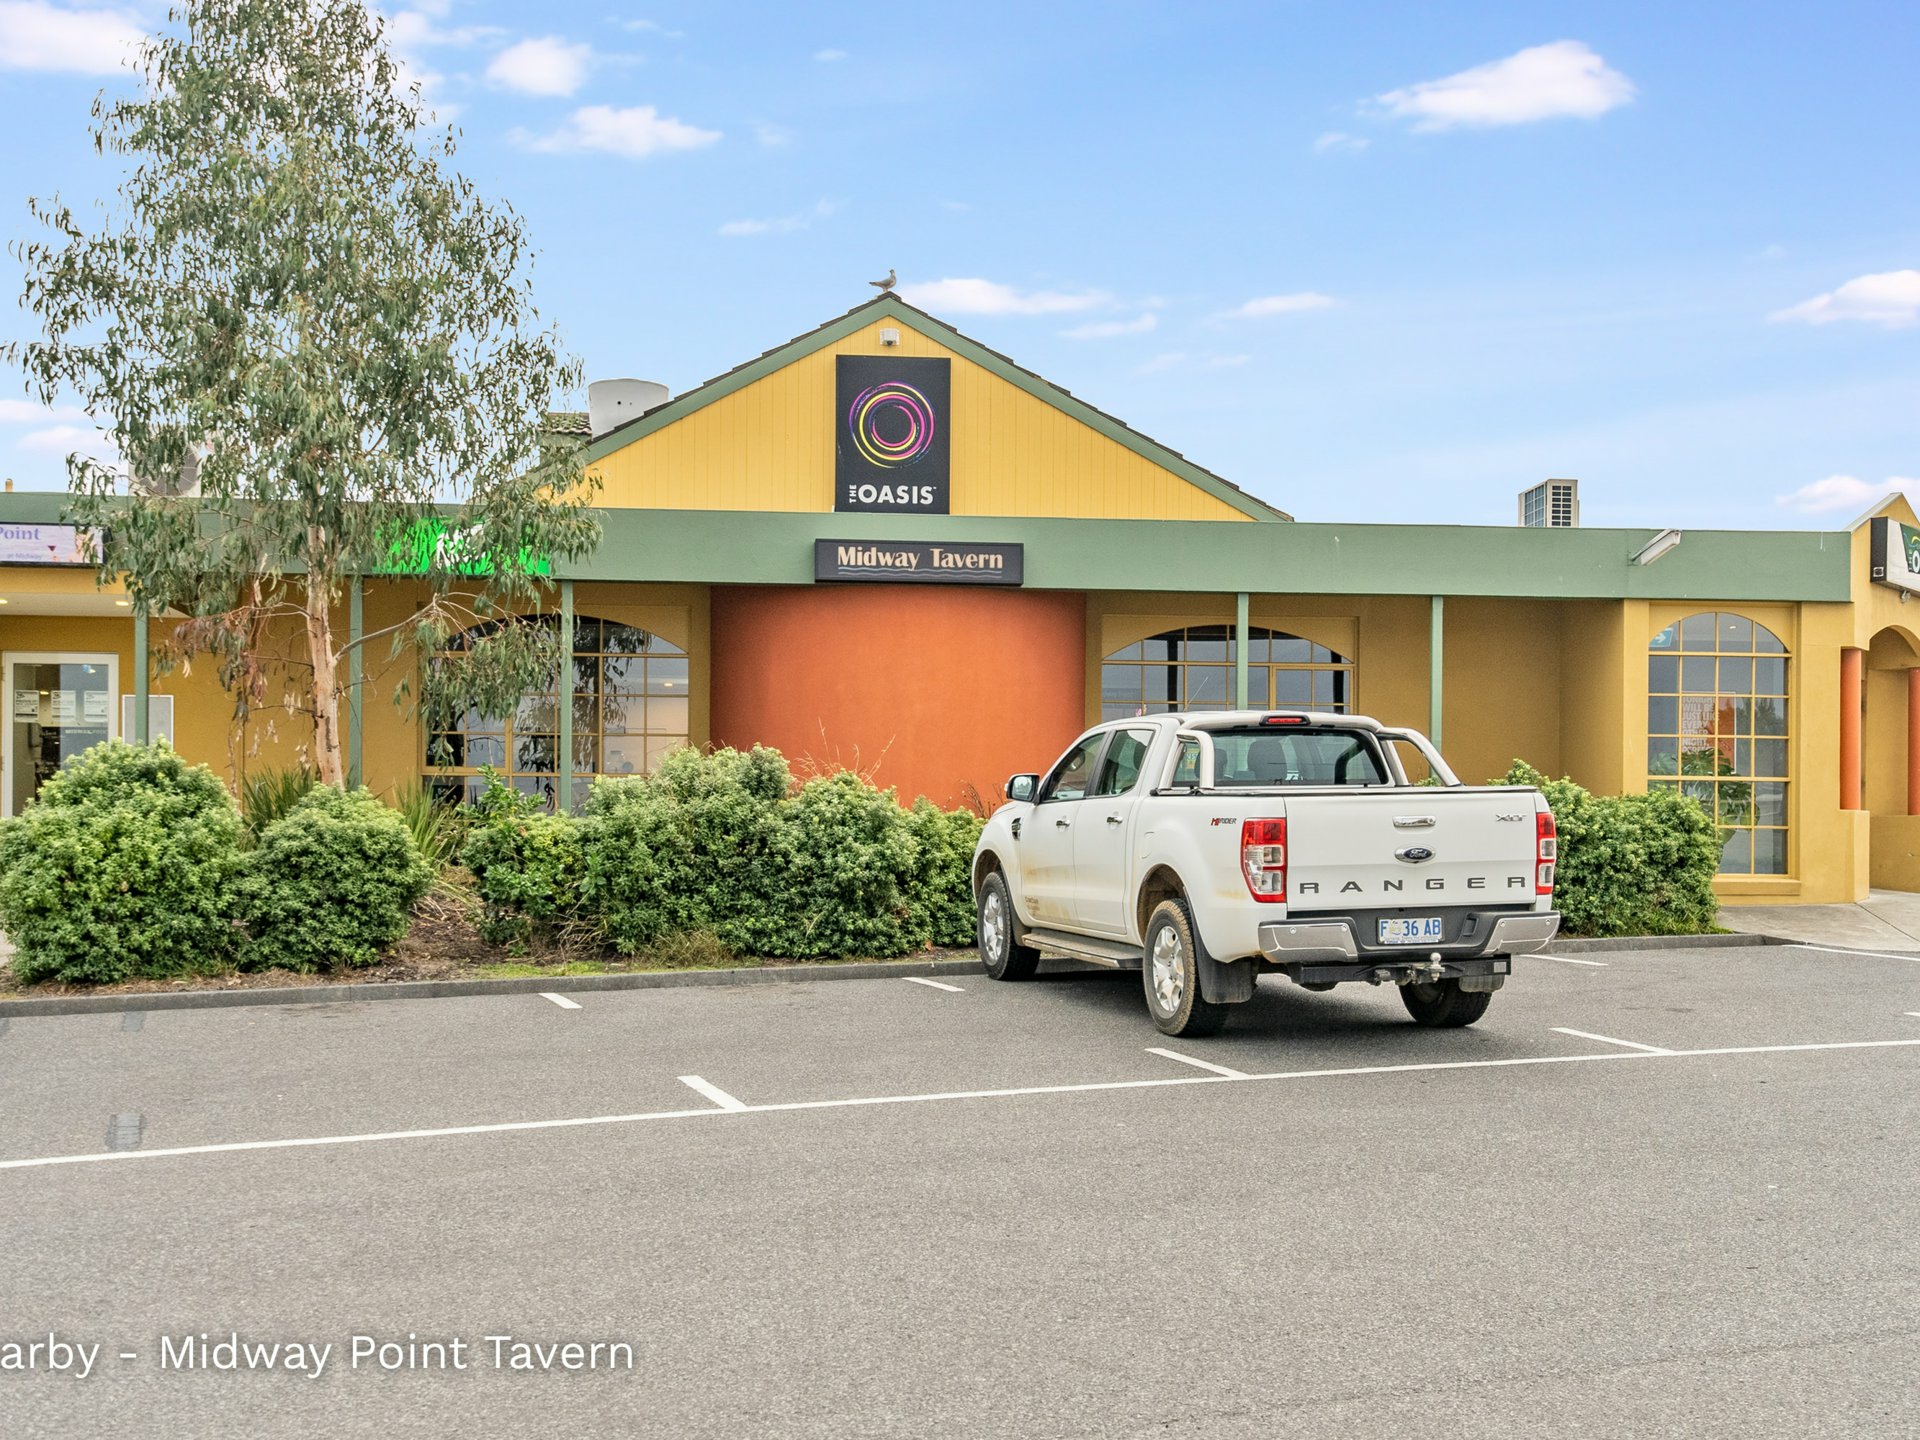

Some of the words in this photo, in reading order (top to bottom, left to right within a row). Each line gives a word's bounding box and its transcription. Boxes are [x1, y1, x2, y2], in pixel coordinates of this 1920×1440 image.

[849, 484, 857, 504] THE
[858, 484, 934, 505] OASIS
[837, 546, 920, 571] Midway
[929, 548, 1003, 569] Tavern
[1299, 876, 1526, 895] RANGER
